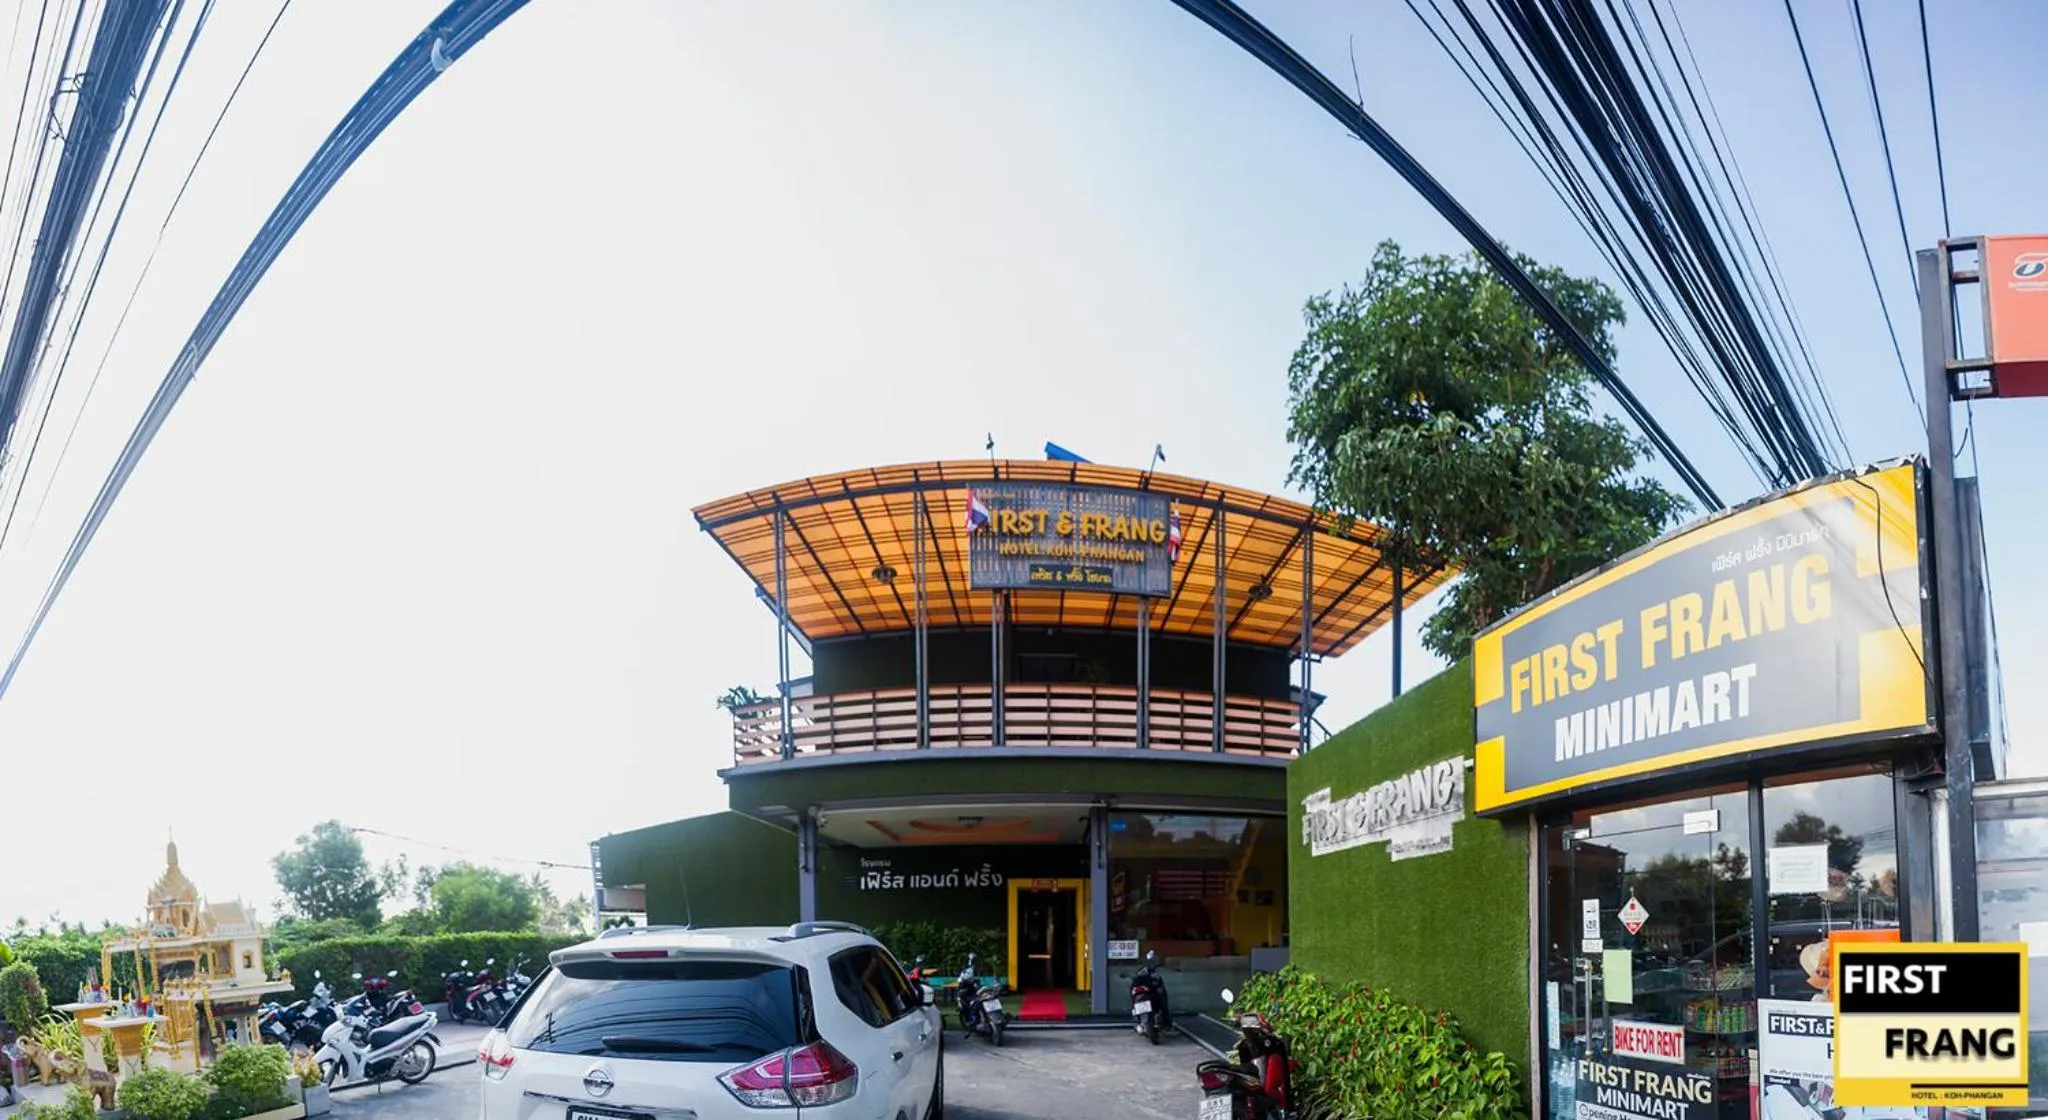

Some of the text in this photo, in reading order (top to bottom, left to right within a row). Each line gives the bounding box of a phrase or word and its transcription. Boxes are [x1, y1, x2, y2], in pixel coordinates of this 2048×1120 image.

[989, 508, 1048, 536] IRST
[1081, 512, 1167, 544] FRANG
[1000, 541, 1039, 556] HOTEL
[1510, 554, 1833, 714] FIRST FRANG
[1555, 663, 1758, 763] MINIMART
[1614, 1025, 1683, 1058] BIKE FOR RENT
[1578, 1060, 1712, 1104] FIRST FRANG
[1597, 1086, 1690, 1120] MINIMART
